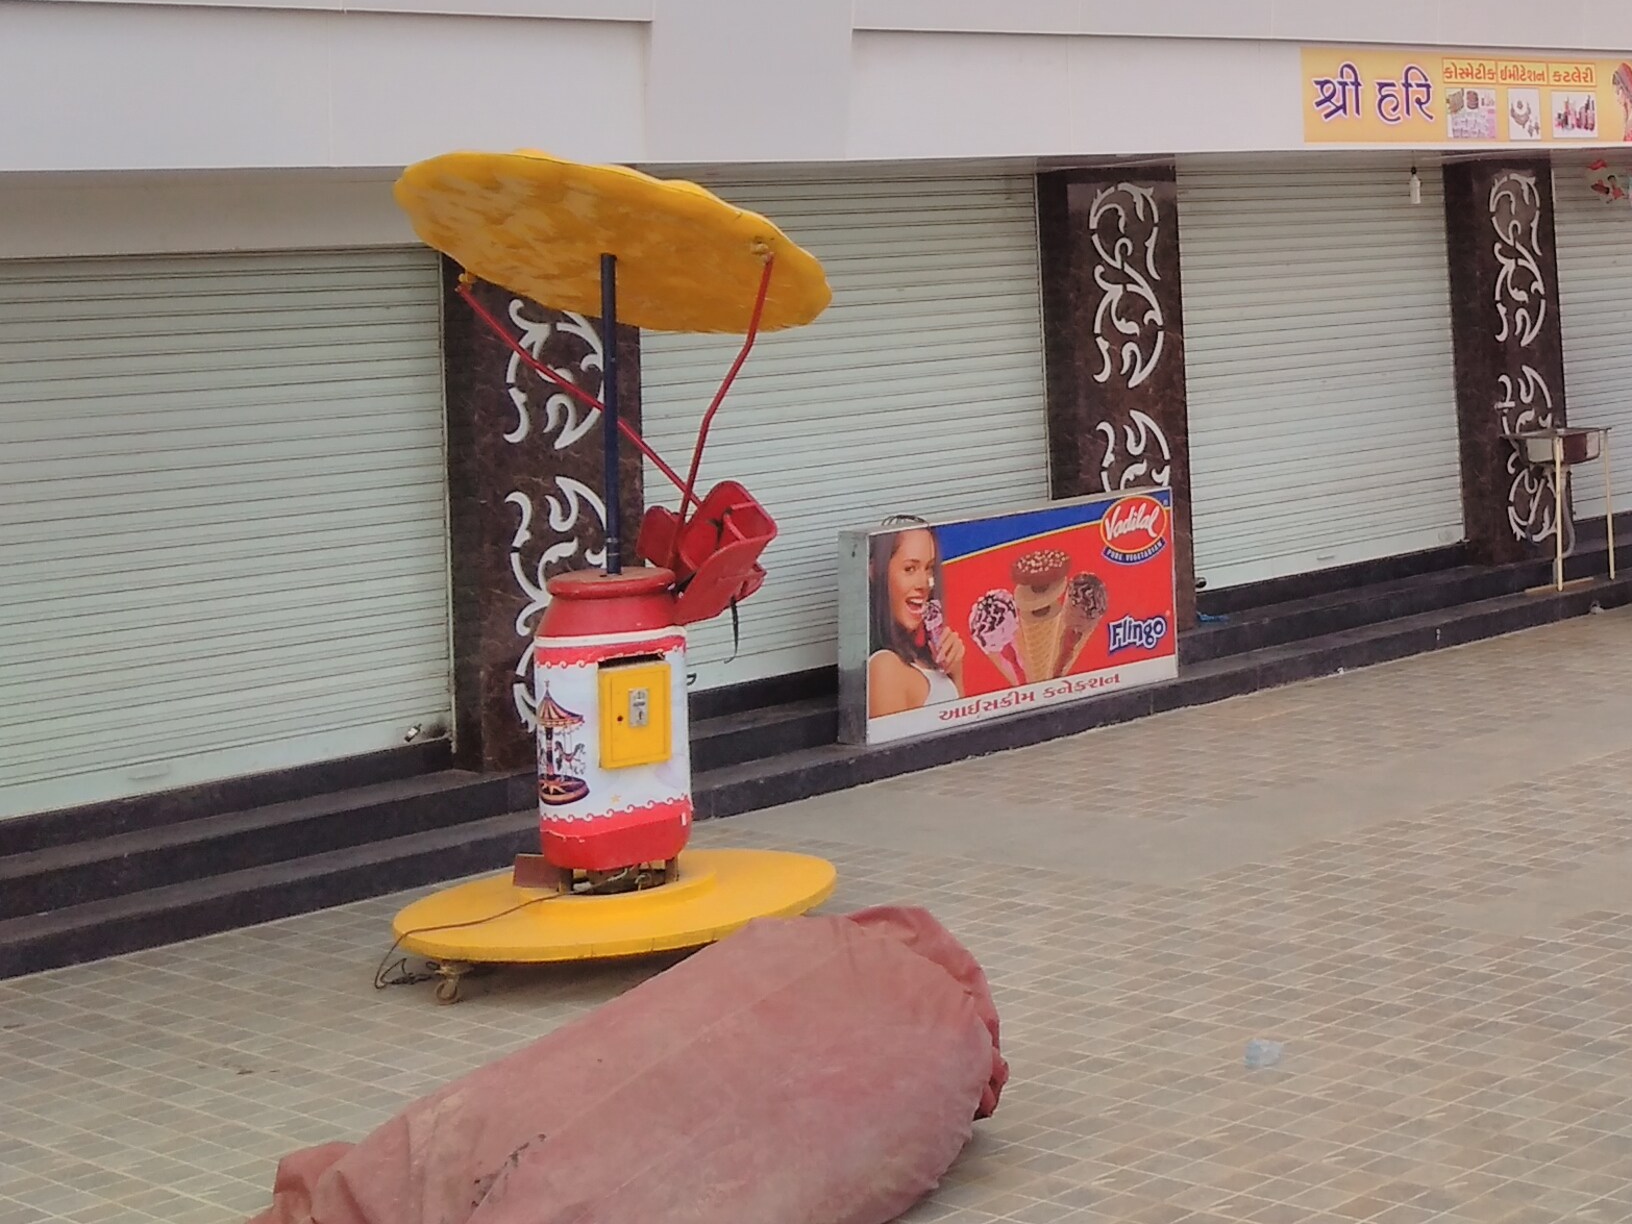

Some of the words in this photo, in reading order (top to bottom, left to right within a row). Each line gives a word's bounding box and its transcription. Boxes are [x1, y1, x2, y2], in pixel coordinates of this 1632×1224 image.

[1312, 61, 1363, 122] श्री
[1374, 63, 1435, 125] हरि
[1552, 66, 1594, 83] કટલેરી
[1104, 502, 1160, 541] Vadilal
[1109, 616, 1167, 652] Flingo
